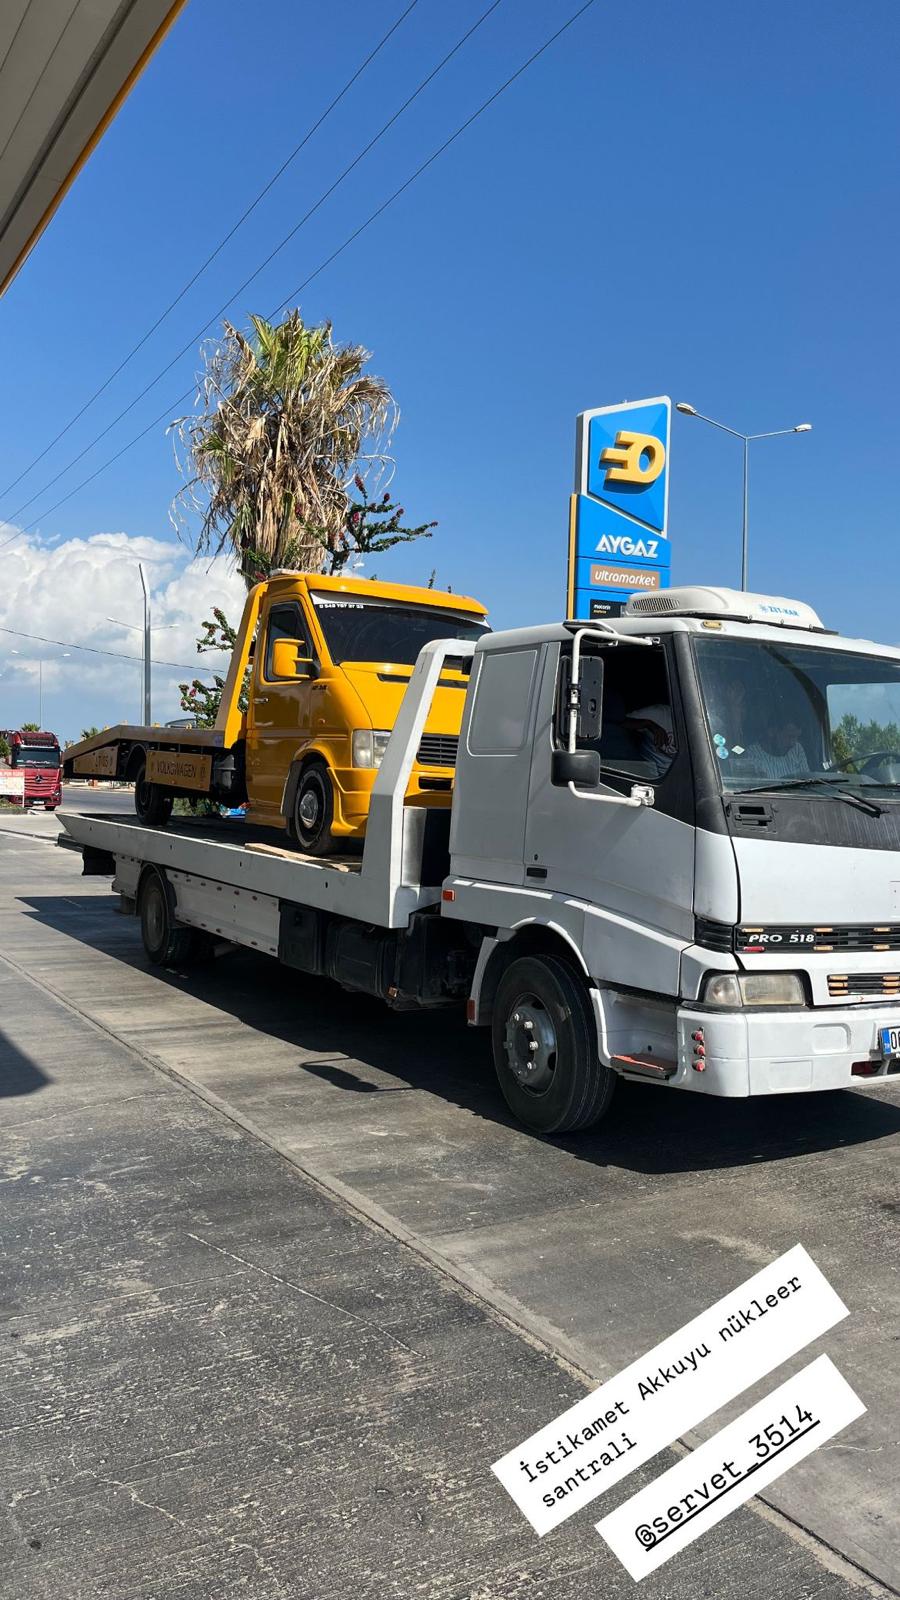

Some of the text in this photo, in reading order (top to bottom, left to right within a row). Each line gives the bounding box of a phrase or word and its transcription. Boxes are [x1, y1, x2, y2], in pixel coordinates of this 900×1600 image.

[595, 534, 659, 559] AYGAZ
[594, 570, 656, 586] ultramarket
[748, 933, 815, 943] PRO 518
